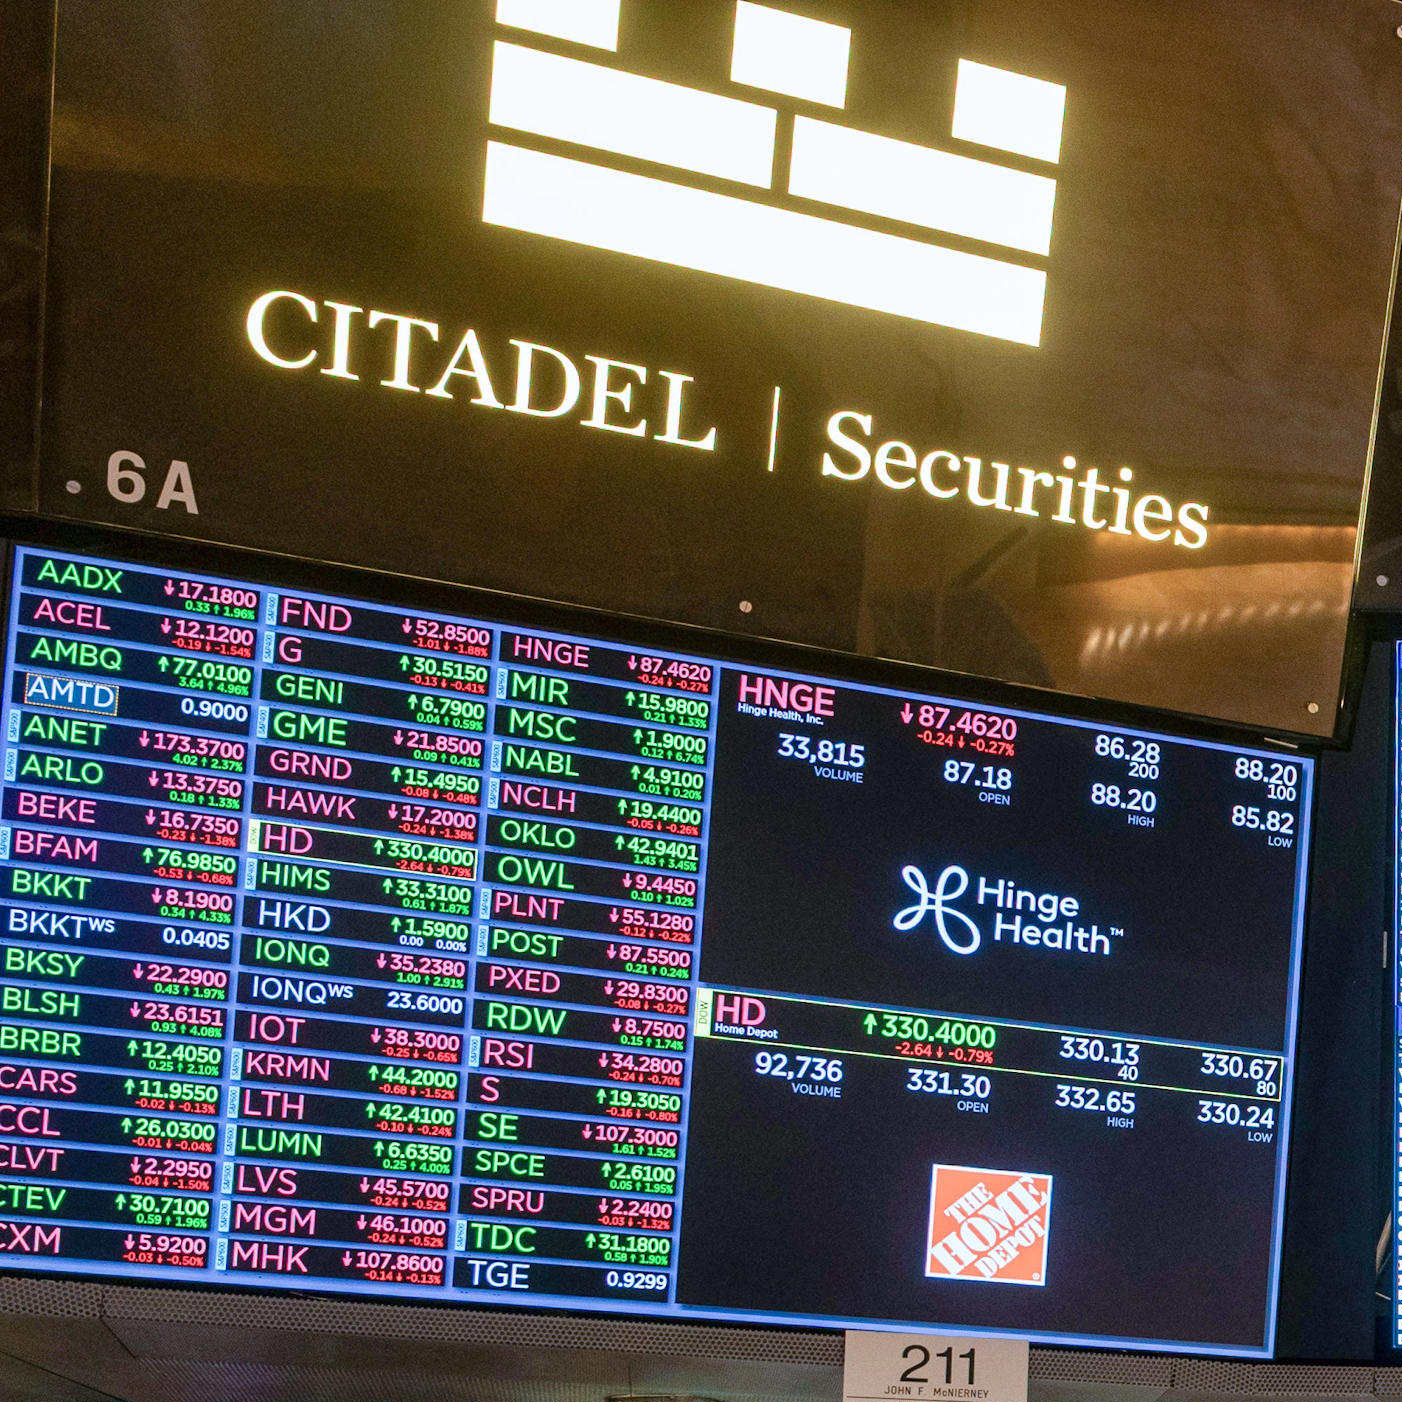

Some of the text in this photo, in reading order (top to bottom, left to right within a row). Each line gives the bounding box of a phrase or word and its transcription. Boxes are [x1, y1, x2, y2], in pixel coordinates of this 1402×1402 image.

[245, 291, 1211, 550] CITADEL Securities
[107, 450, 198, 514] 6A
[38, 560, 257, 608] AADX 17.1800
[34, 599, 253, 646] ACEL 12.1200
[282, 598, 490, 645] FND 52.8500
[27, 674, 248, 722] AMTD 0.9000
[738, 675, 835, 716] HNGE
[274, 711, 347, 746] GME
[738, 703, 823, 725] Hinge Health, Inc.
[917, 705, 1017, 741] 87.4620
[778, 733, 864, 767] 33,815
[814, 766, 863, 783] VOLUME
[944, 760, 1011, 790] 87.18
[979, 792, 1010, 805] OPEN
[500, 820, 575, 848] OKLO
[978, 877, 1079, 919] Hinge
[256, 938, 329, 967] IONQ
[717, 994, 765, 1025] HD
[715, 1023, 778, 1039] Home Depot
[881, 1014, 996, 1048] 330.4000
[241, 1128, 321, 1156] LUMN
[944, 1182, 994, 1225] THE
[931, 1176, 1048, 1276] HOME
[974, 1215, 1046, 1279] DEPOT
[468, 1260, 667, 1290] TGE 0.9299
[900, 1345, 975, 1385] 211
[884, 1386, 911, 1395] JOHN
